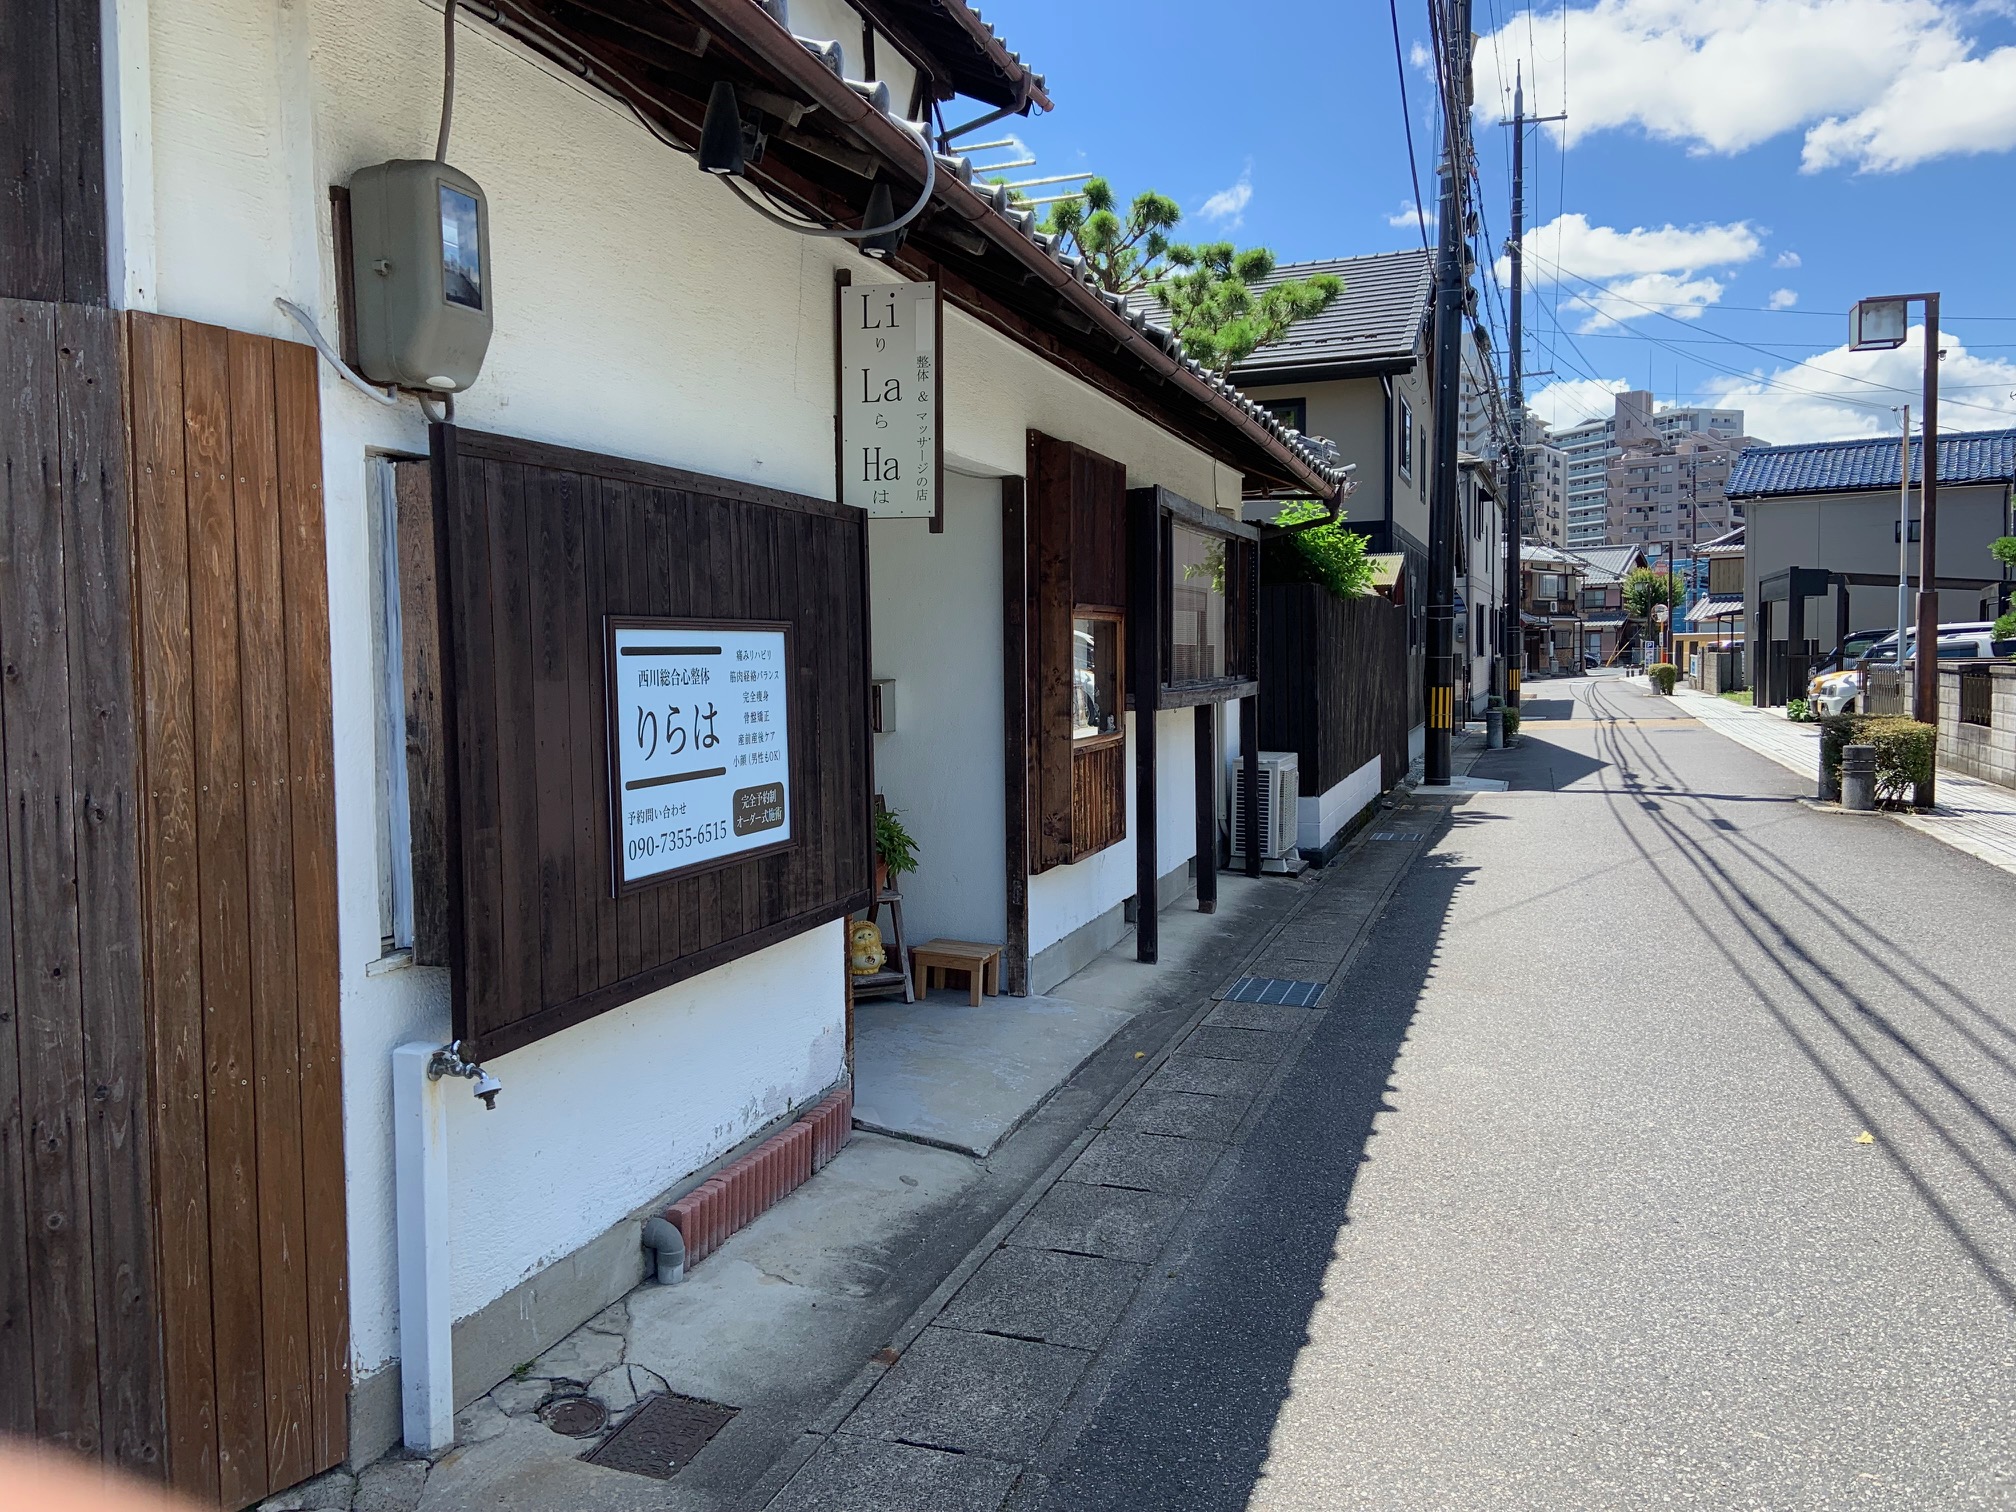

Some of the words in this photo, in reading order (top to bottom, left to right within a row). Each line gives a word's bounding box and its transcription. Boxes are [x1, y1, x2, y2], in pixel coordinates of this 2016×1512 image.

[861, 292, 899, 329] Li
[875, 337, 886, 352] り
[916, 355, 929, 383] 整体
[861, 368, 903, 404] La
[917, 390, 929, 403] &
[875, 413, 888, 429] ら
[862, 446, 901, 482] Ha
[916, 411, 928, 502] マッサージの店
[873, 489, 890, 504] は
[638, 667, 710, 688] 西川総合心整体
[744, 710, 770, 725] 骨盤矯正
[637, 701, 720, 762] りらは
[738, 731, 776, 746] 産前産後ケア
[741, 789, 777, 809] 完全予約制
[628, 802, 687, 826] 予約問い合わせ
[736, 806, 783, 829] オーダー式施術
[628, 819, 728, 862] 090-7355-6515
